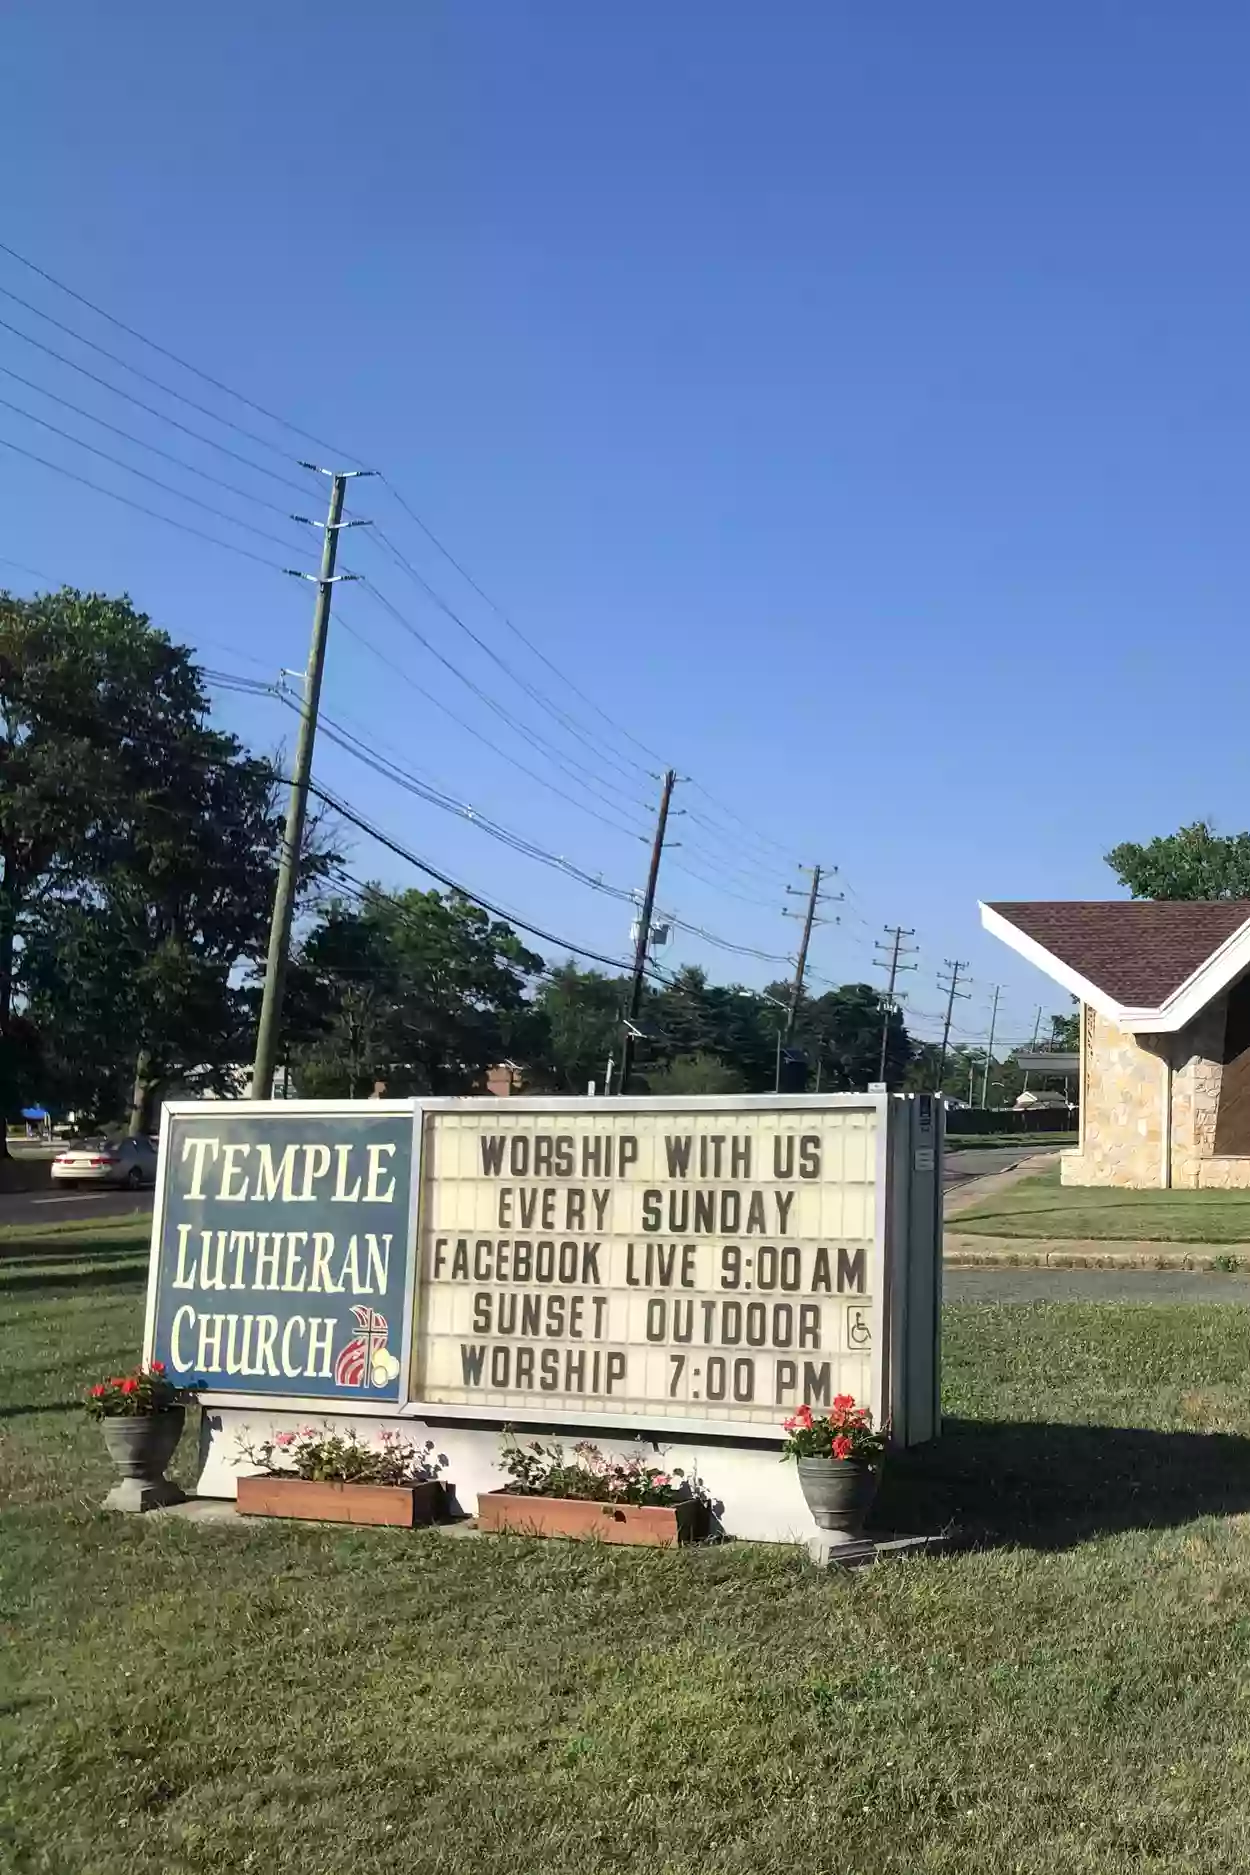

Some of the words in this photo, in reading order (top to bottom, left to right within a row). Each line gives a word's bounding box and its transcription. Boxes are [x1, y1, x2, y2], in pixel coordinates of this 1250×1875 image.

[181, 1137, 397, 1203] TEMPLE
[480, 1134, 638, 1178] WORSHIP
[664, 1135, 752, 1179] WITH
[773, 1135, 822, 1180] US
[498, 1187, 610, 1231] EVERY
[641, 1189, 796, 1235] SUNDAY
[172, 1223, 394, 1295] LUTHERAN
[433, 1238, 602, 1286] FACEBOOK
[625, 1243, 696, 1288] LIVE
[170, 1304, 338, 1378] CHURCH
[472, 1292, 608, 1340] SUNSET
[646, 1299, 822, 1349] OUTDOOR
[460, 1343, 627, 1395] WORSHIP
[669, 1354, 755, 1402] 7:00
[776, 1360, 832, 1408] PM
